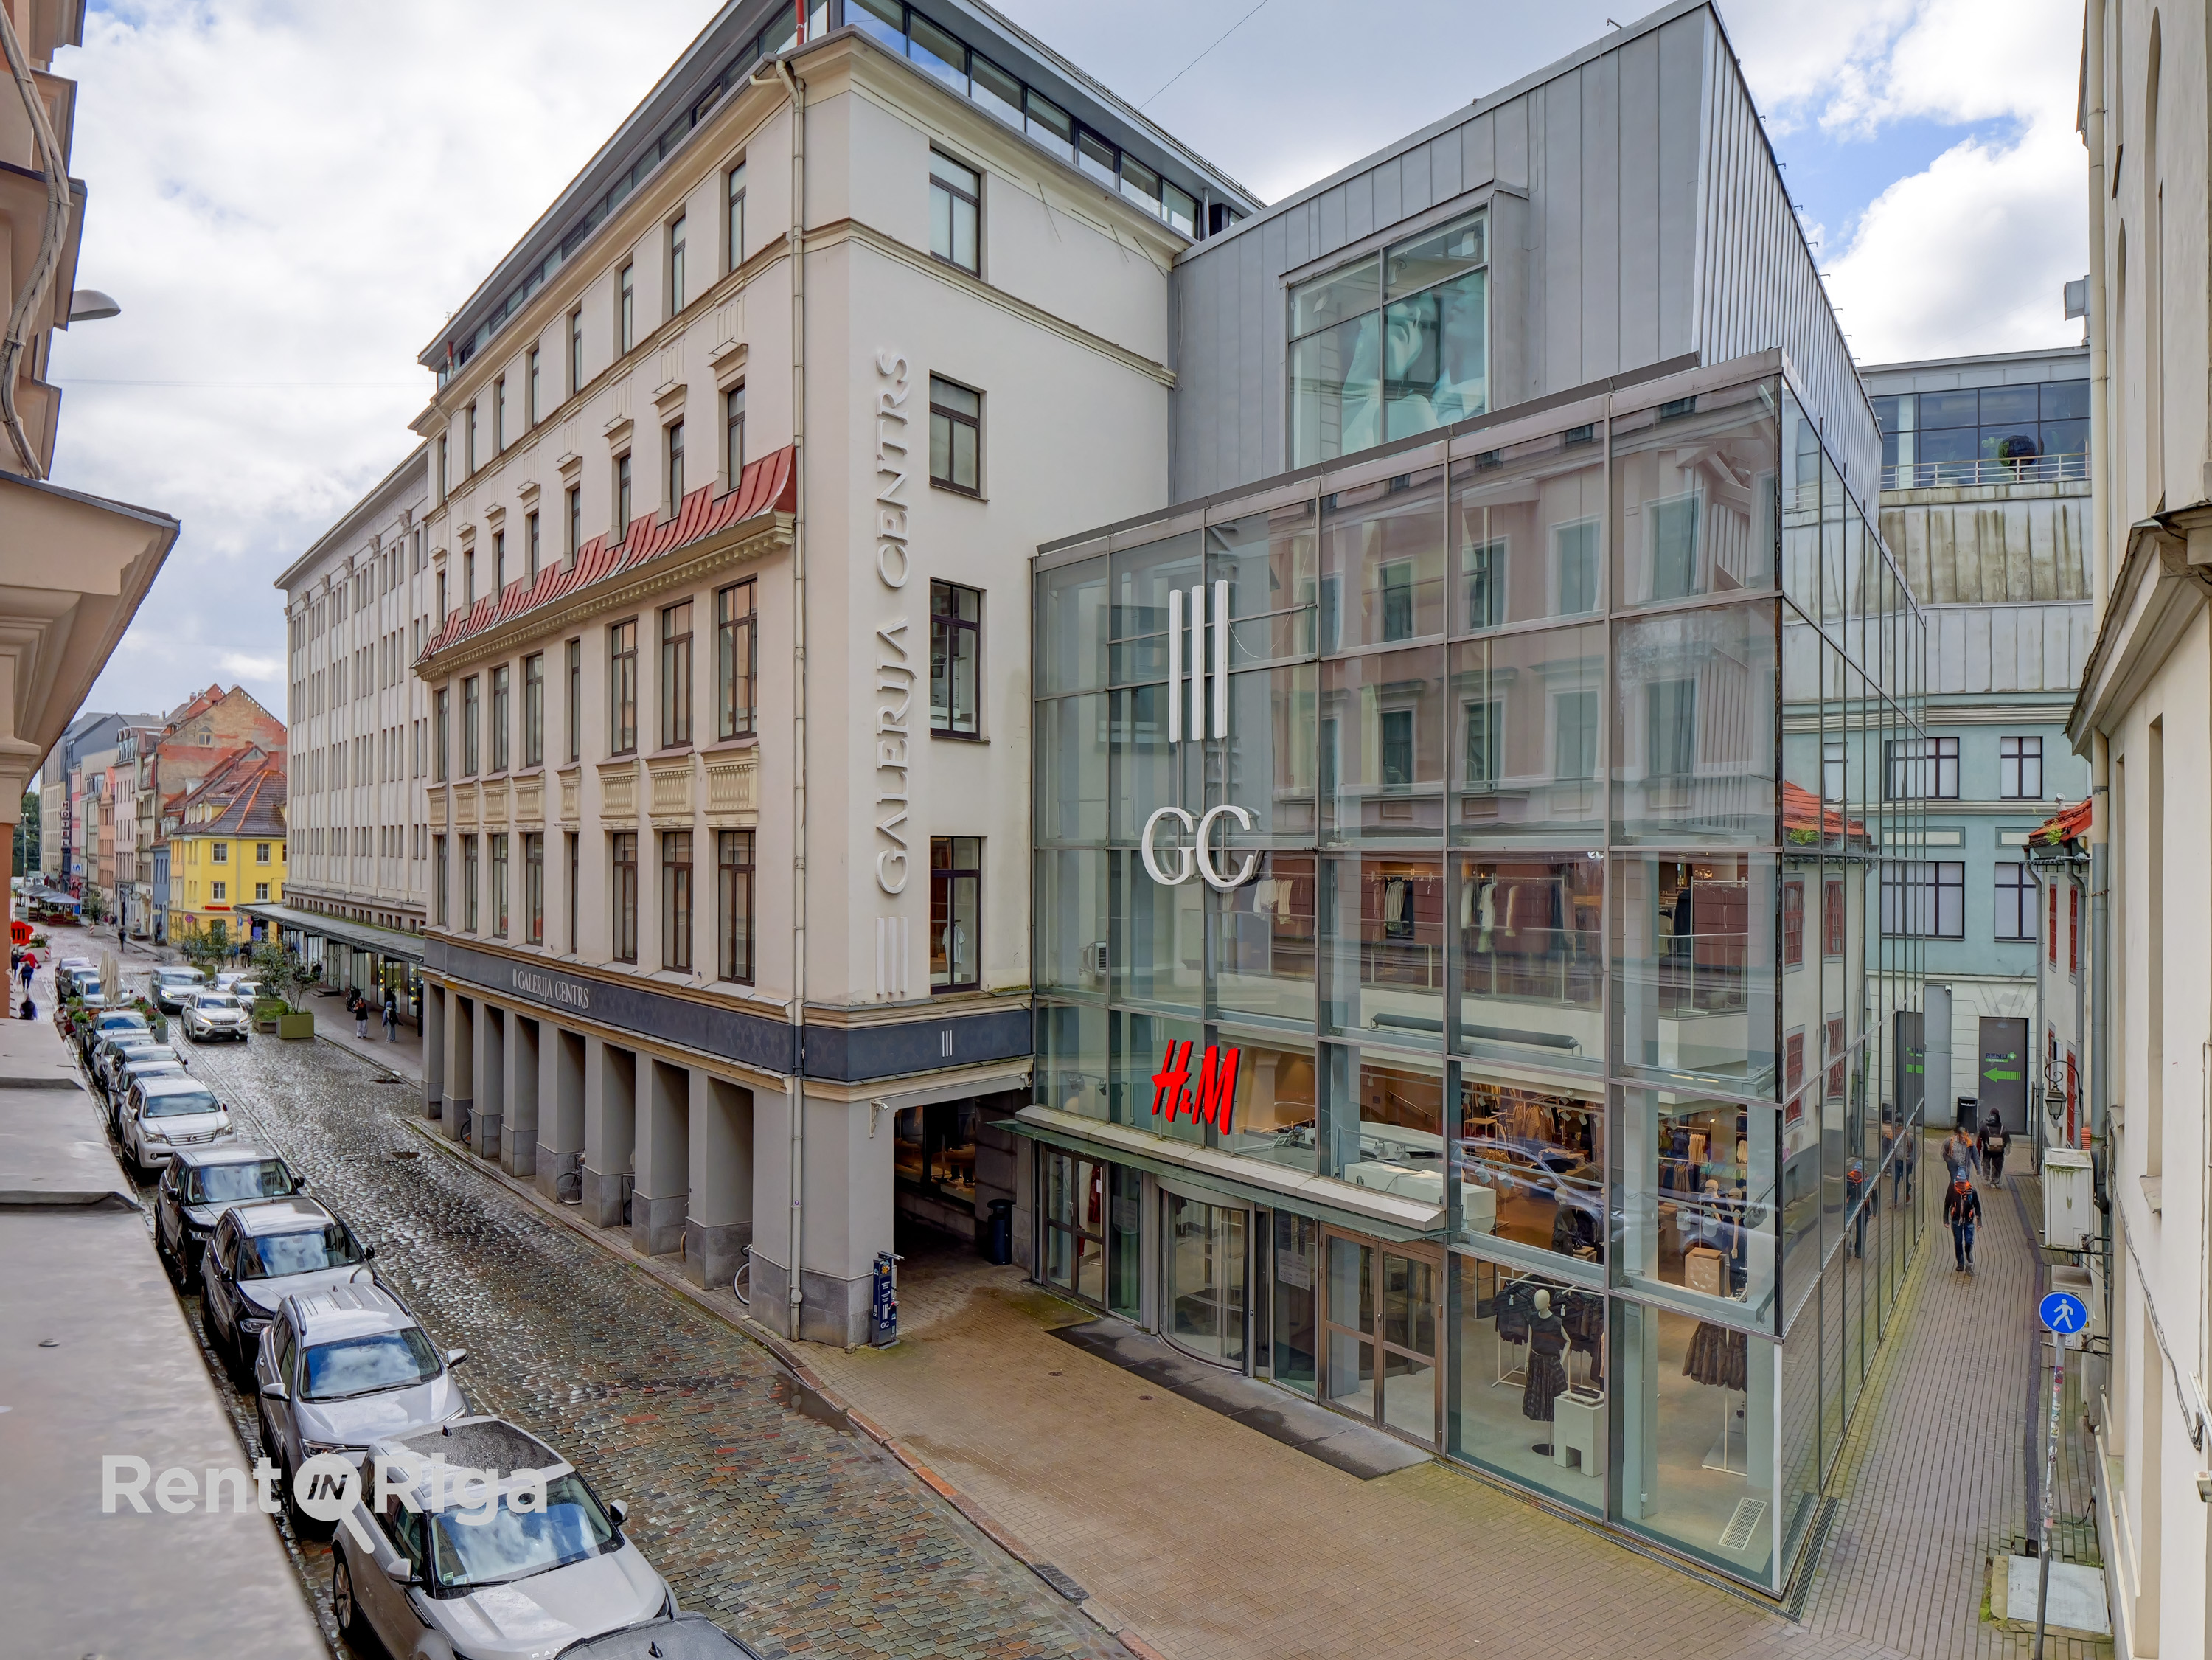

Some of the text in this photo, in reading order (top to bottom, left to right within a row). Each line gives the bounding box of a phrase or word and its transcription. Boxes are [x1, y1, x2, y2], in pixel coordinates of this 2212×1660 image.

[875, 353, 917, 895] GALERIJA CENTRS
[1141, 805, 1254, 887] GC
[518, 970, 589, 1009] GALERIJA CENTRS
[1151, 1038, 1240, 1136] H&M
[880, 1321, 889, 1329] GC
[532, 1647, 562, 1659] RAN
